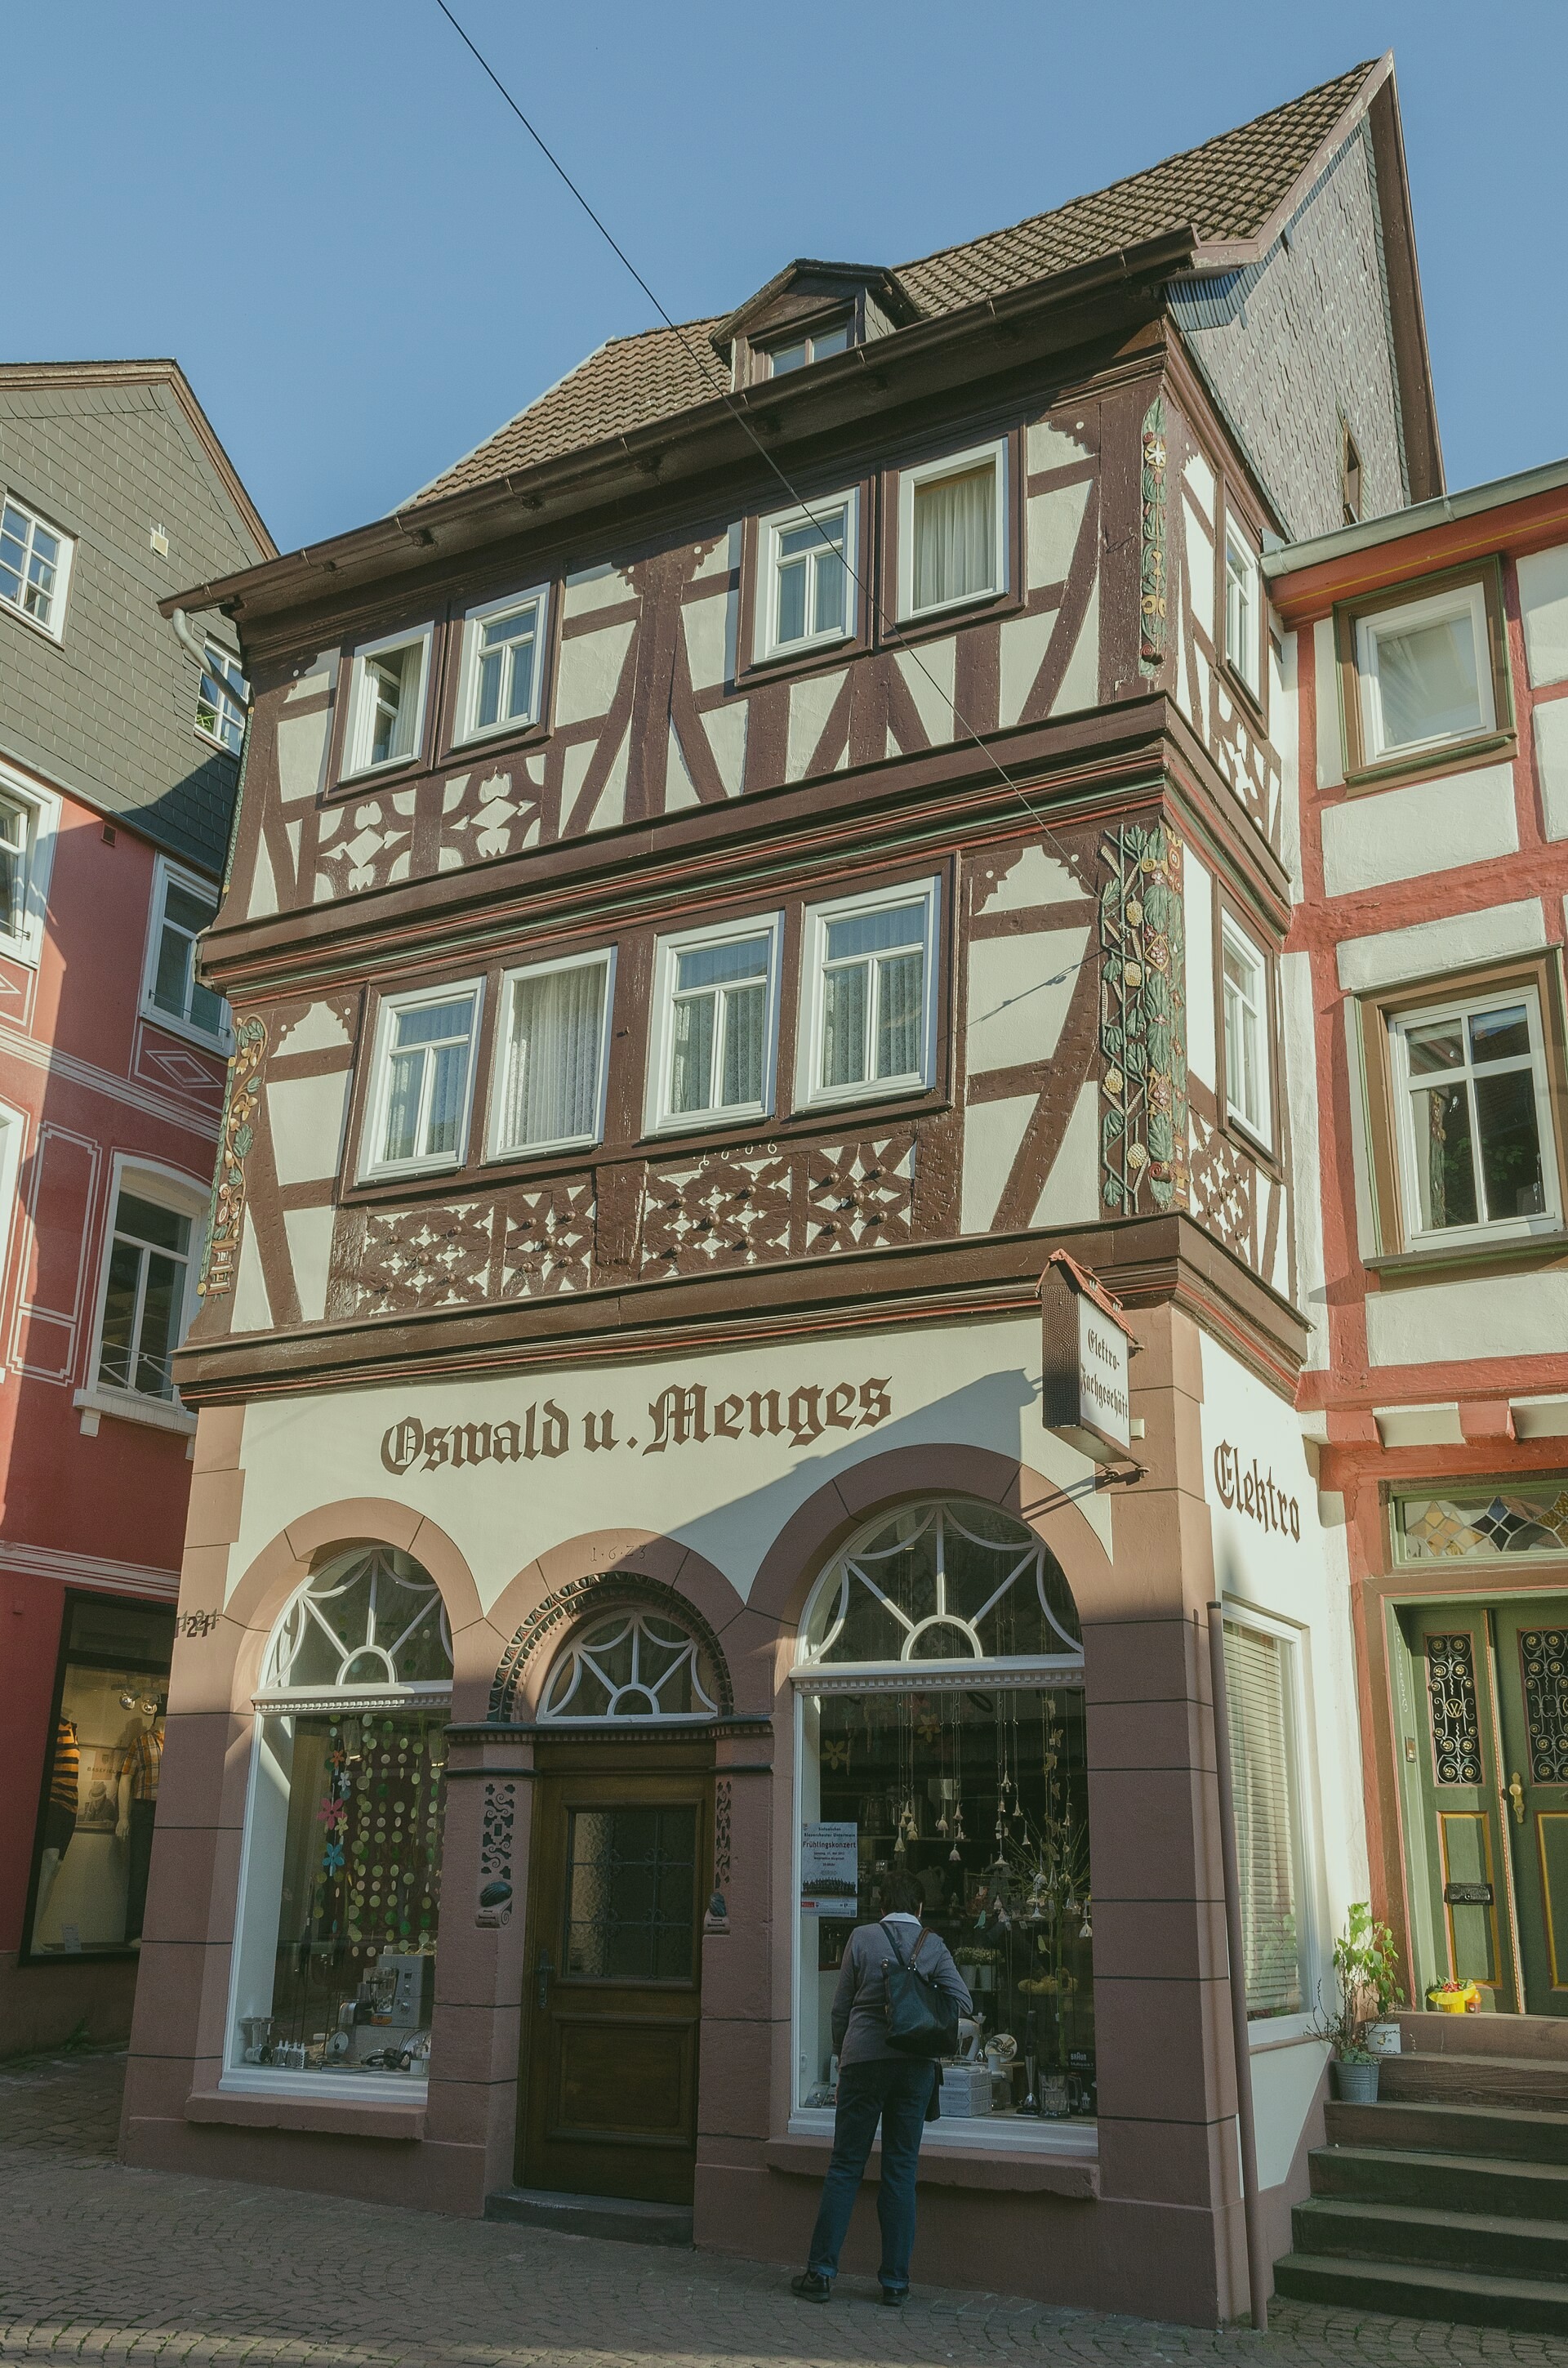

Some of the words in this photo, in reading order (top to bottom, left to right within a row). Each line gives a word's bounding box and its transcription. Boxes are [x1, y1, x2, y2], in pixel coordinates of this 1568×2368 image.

[1087, 1328, 1120, 1371] Elektro-
[380, 1398, 570, 1476] Oswald
[581, 1408, 639, 1453] u.
[642, 1376, 893, 1456] Menges
[1214, 1438, 1301, 1544] Elektro
[803, 1841, 857, 1849] Frühlingskonzert
[1070, 2052, 1087, 2061] BRAUN
